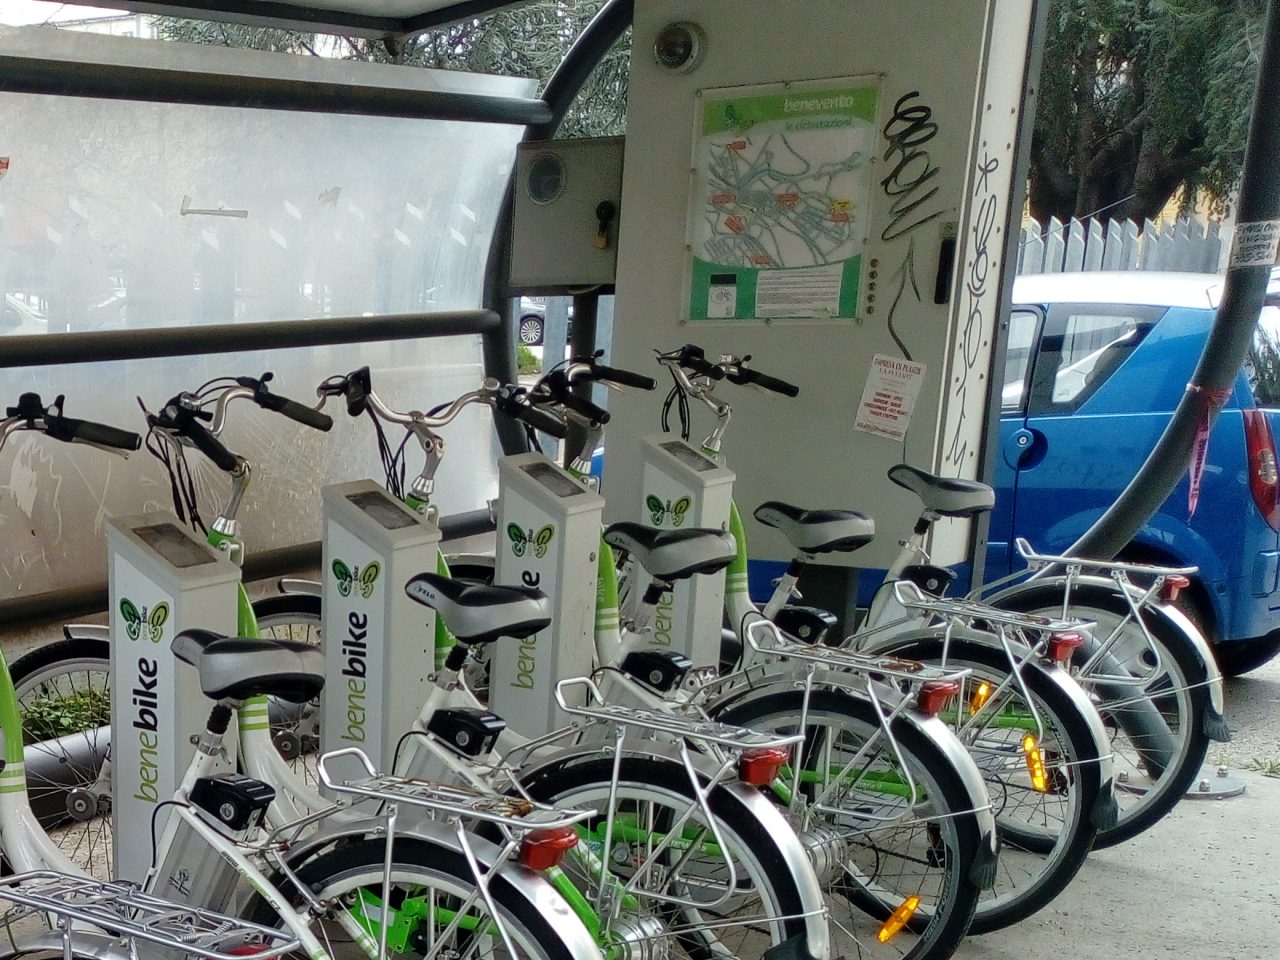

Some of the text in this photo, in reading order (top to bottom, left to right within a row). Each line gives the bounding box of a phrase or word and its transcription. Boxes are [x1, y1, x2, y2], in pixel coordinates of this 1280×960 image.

[783, 95, 853, 113] benevento
[132, 657, 159, 805] benebike
[341, 610, 369, 744] benebike
